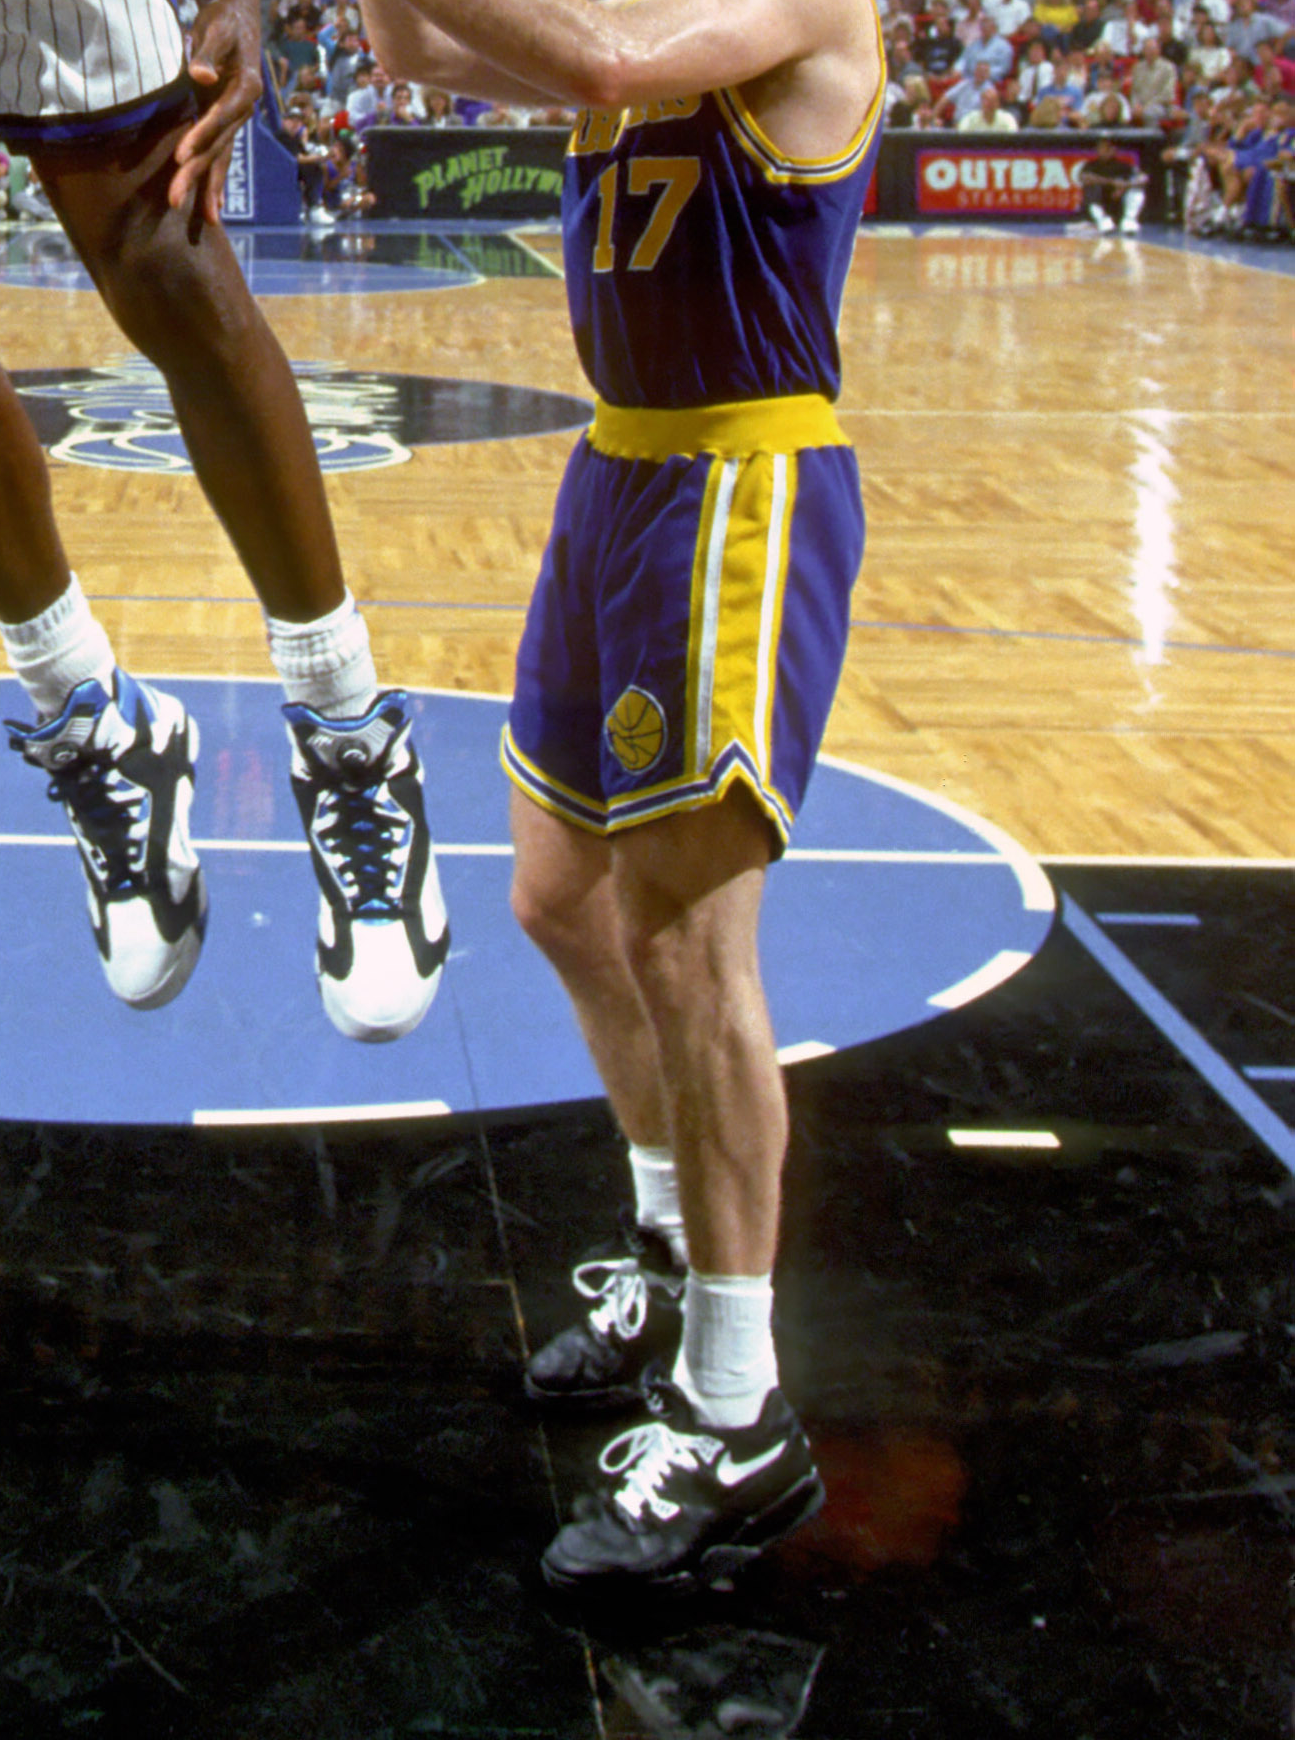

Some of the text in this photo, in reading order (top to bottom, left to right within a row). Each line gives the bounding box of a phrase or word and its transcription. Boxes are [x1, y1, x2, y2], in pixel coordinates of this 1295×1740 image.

[412, 146, 509, 209] PLANET
[957, 191, 1082, 206] STEAKHOUS
[593, 156, 701, 273] 17
